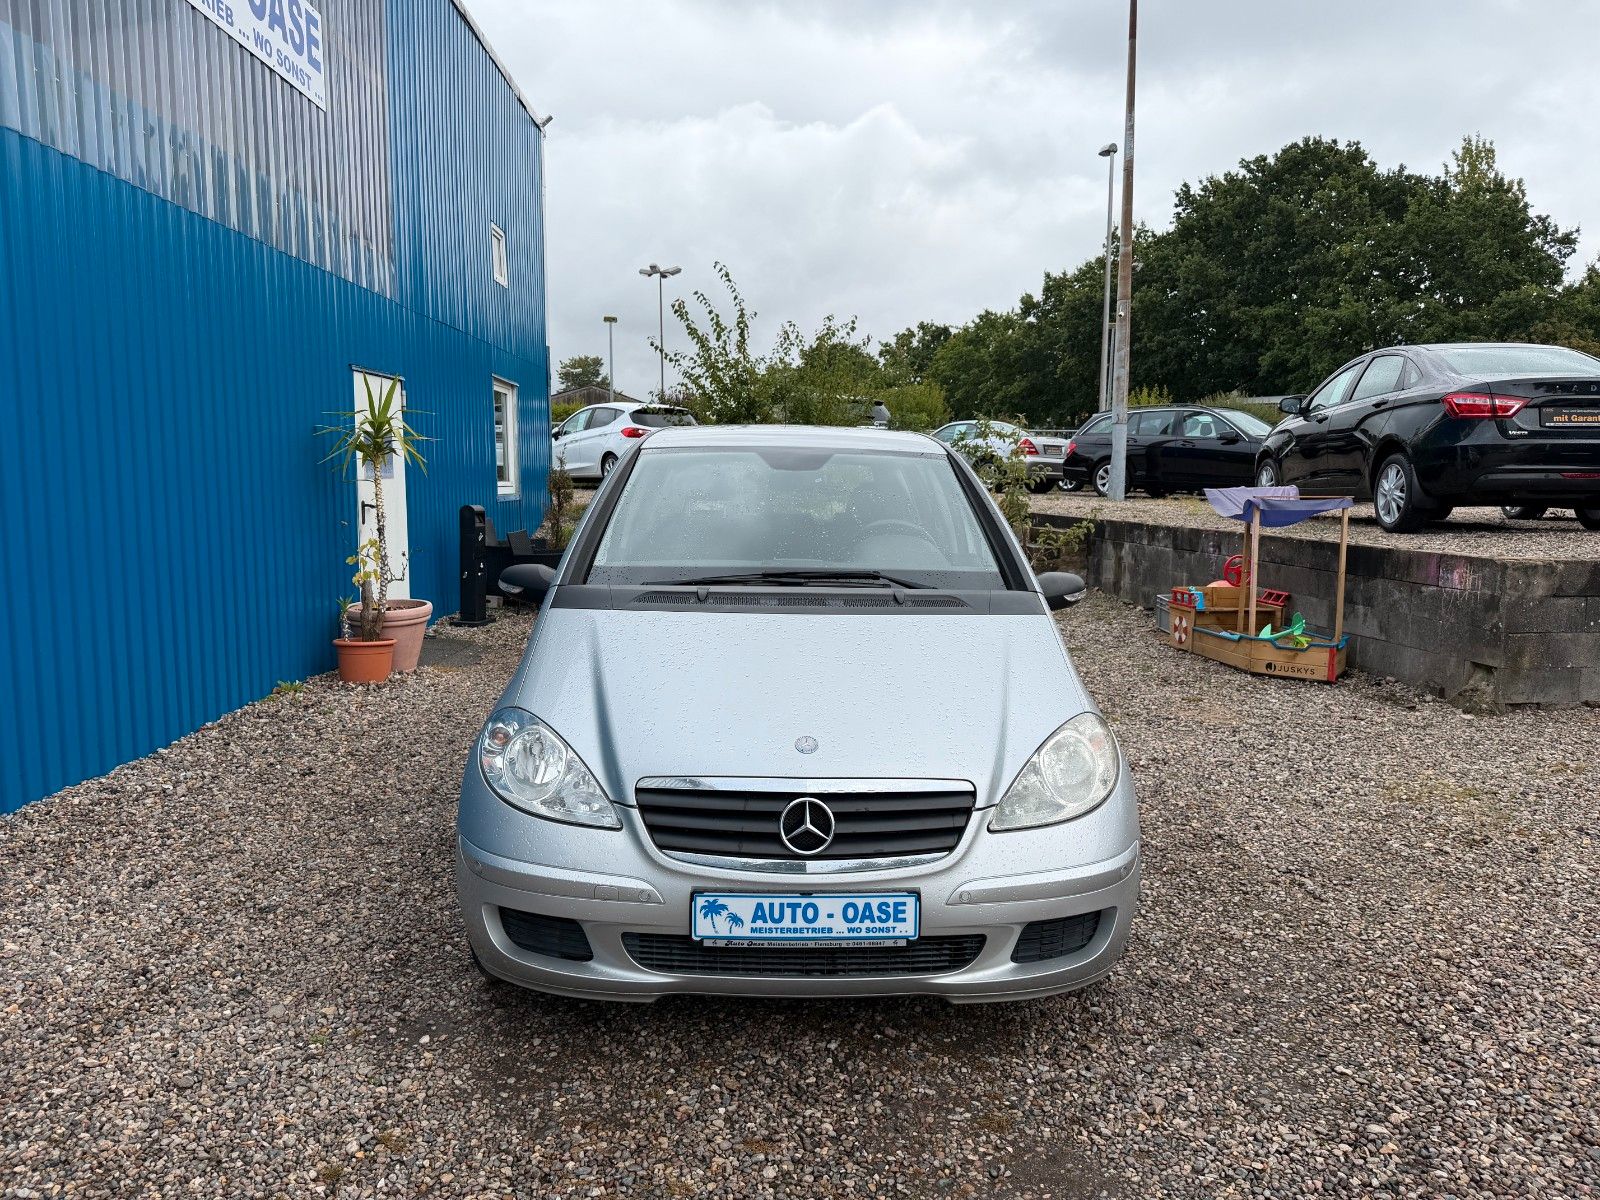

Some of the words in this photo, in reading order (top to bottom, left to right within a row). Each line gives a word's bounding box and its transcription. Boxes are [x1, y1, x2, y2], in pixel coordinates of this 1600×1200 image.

[252, 27, 273, 58] WO
[276, 48, 312, 91] SONST
[1553, 414, 1569, 422] mit
[1277, 664, 1316, 675] JUSKYS
[750, 902, 819, 924] AUTO
[841, 902, 907, 924] OASE
[865, 926, 897, 934] SONST
